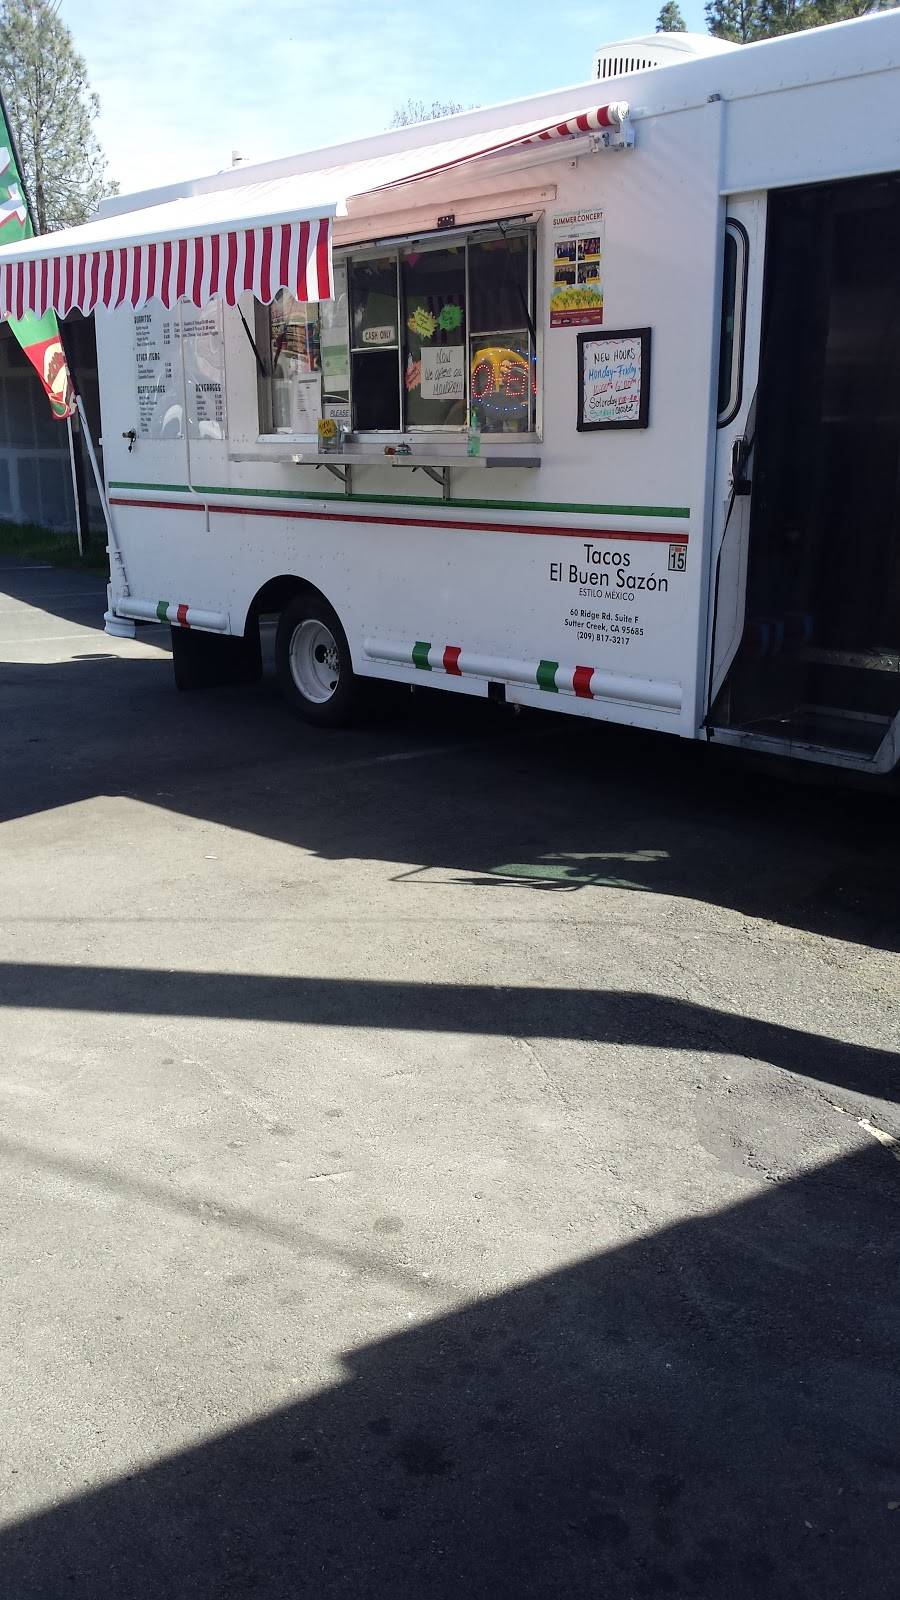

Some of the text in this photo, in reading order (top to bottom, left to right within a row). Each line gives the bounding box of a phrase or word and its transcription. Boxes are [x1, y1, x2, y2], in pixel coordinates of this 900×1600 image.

[553, 212, 603, 226] SUMMER CONCERT
[365, 329, 392, 341] CASH ONLY
[594, 348, 635, 364] NEW HOURS
[330, 409, 350, 417] PLEASE
[584, 543, 631, 566] Tacos
[671, 552, 685, 570] 15
[550, 562, 668, 592] El Buen Sazón
[579, 587, 603, 598] ESTILO
[570, 608, 579, 616] 60
[580, 609, 600, 620] Ridge
[602, 612, 613, 621] Rd.
[614, 613, 633, 623] Suite
[564, 618, 644, 636] Sutter Creek, CA 95685
[577, 631, 630, 645] (209) 817-3217
